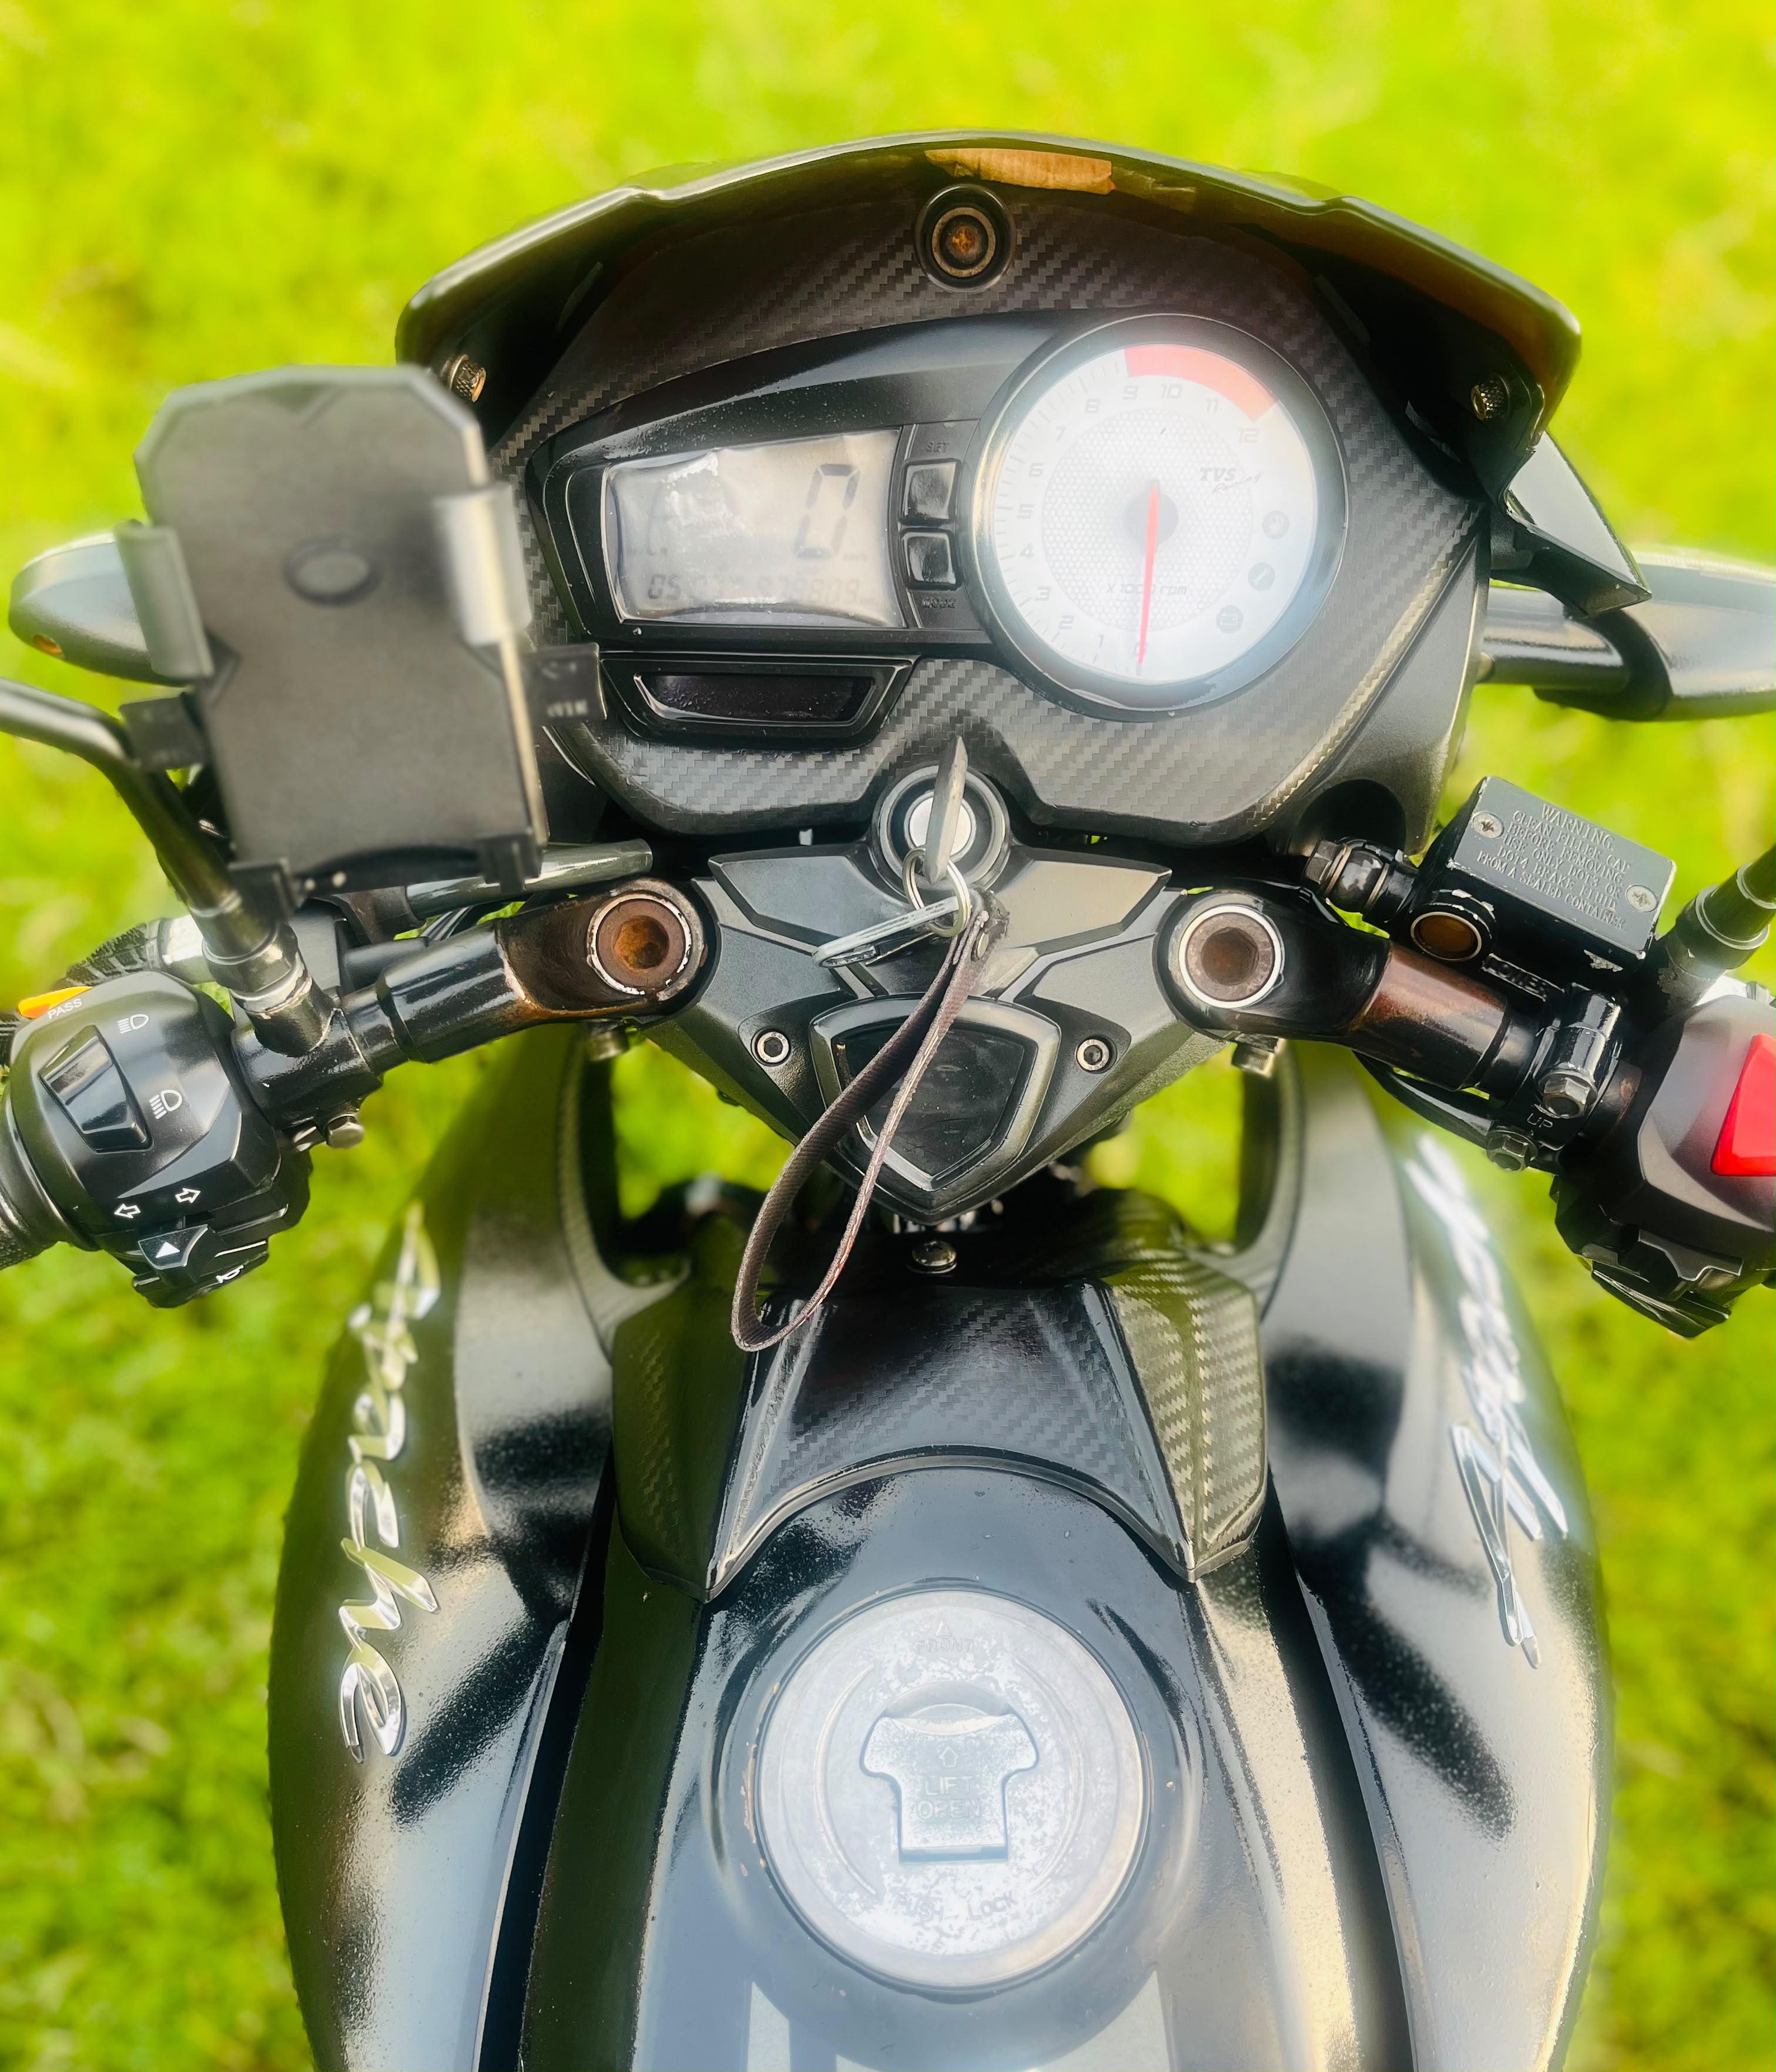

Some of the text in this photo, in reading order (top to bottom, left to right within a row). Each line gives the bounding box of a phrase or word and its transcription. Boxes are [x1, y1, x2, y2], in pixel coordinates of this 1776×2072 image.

[1122, 384, 1139, 400] 9
[1161, 384, 1182, 398] 10
[1085, 398, 1101, 414] 8
[1205, 398, 1220, 413] 11
[1055, 427, 1066, 441] 7
[1238, 427, 1260, 444] 12
[926, 442, 950, 453] SET
[1028, 462, 1044, 477] 6
[1199, 467, 1237, 482] TVS
[796, 464, 860, 559] 0
[1017, 504, 1033, 519] 5
[1020, 544, 1034, 558] 4
[1036, 586, 1050, 601] 3
[1160, 585, 1187, 596] rpm
[920, 598, 957, 609] MODE
[1059, 615, 1074, 629] 2
[1098, 635, 1104, 648] 1
[1507, 822, 1557, 853] BEFORE
[1512, 809, 1631, 874] CLEAN FILLER CAP
[1496, 845, 1530, 870] DOT4
[1532, 862, 1577, 891] BRAKE
[1502, 833, 1529, 854] USE
[1531, 847, 1564, 871] ONLY
[1603, 883, 1623, 899] OR
[1476, 850, 1509, 874] FROM
[1507, 865, 1519, 879] A
[1519, 871, 1564, 900] SEALED
[47, 998, 83, 1020] PASS
[1527, 1114, 1553, 1128] UP
[337, 1198, 441, 1763] Apache
[913, 1637, 974, 1654] FRONT
[924, 1775, 974, 1796] LIFT
[916, 1798, 982, 1820] OPEN
[893, 1890, 1018, 1921] PUSH LOCK
